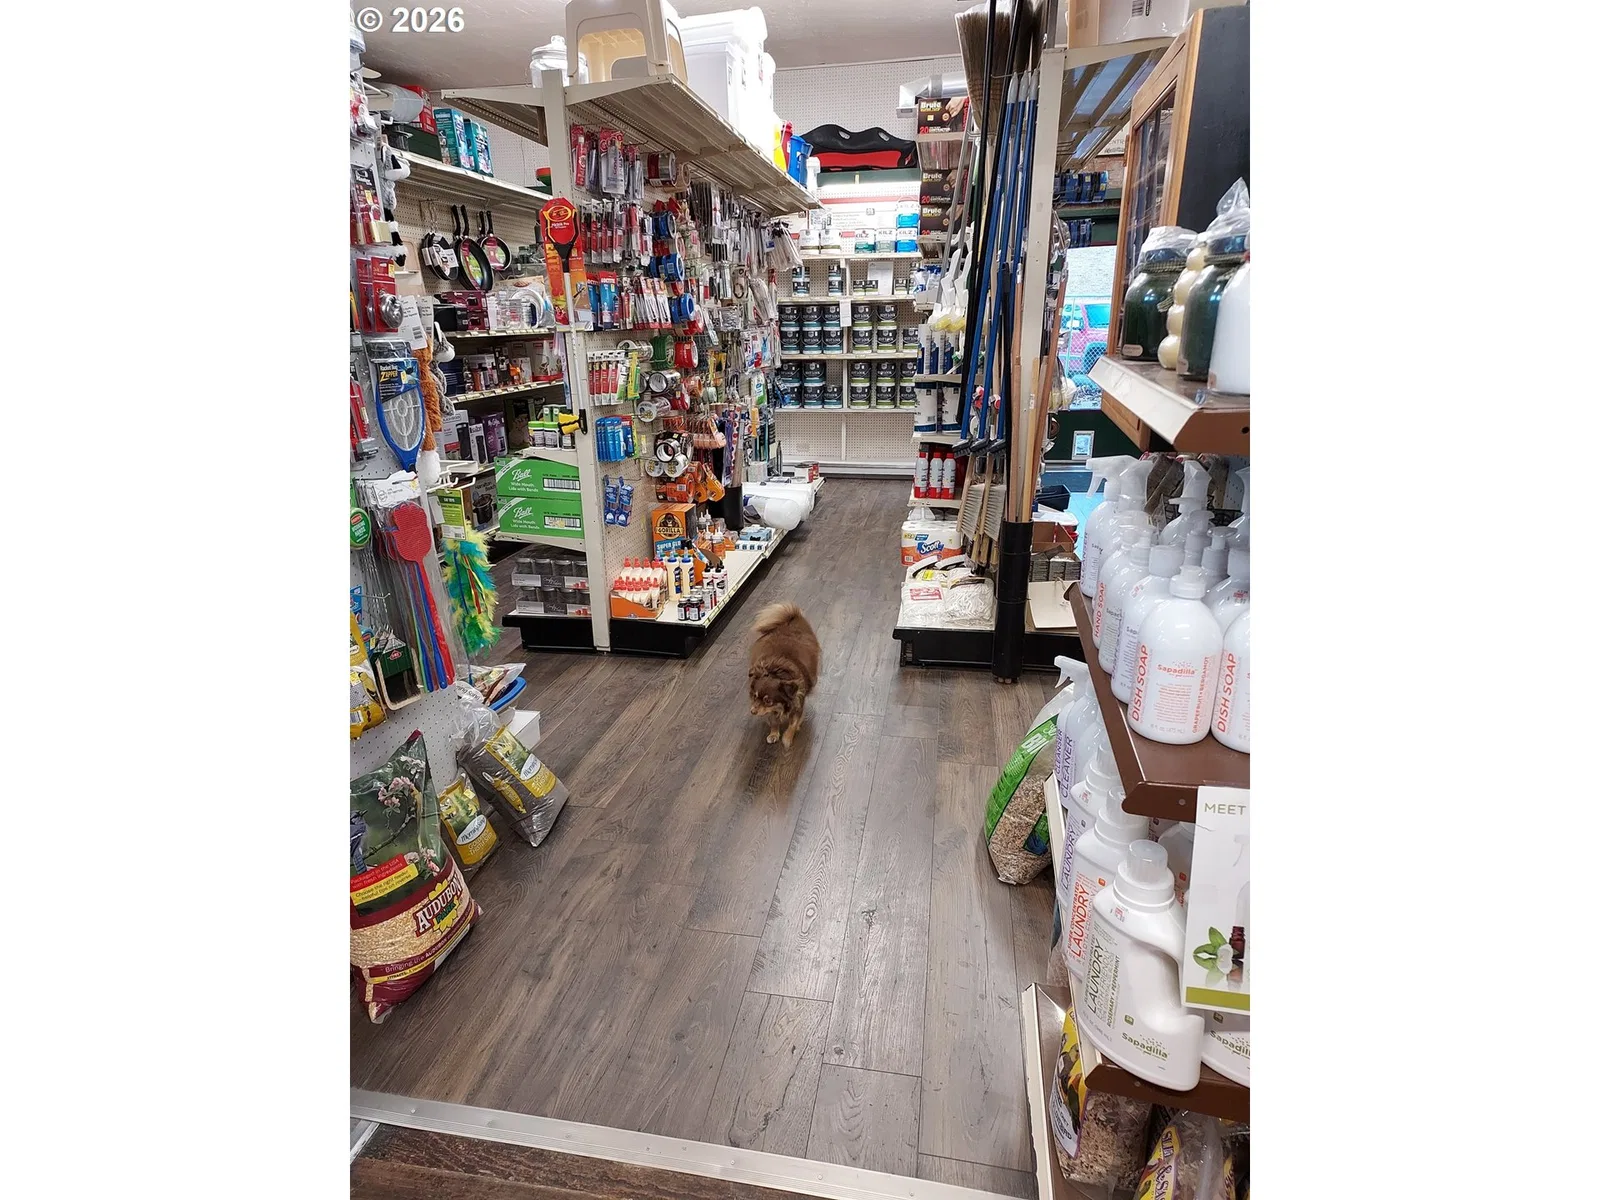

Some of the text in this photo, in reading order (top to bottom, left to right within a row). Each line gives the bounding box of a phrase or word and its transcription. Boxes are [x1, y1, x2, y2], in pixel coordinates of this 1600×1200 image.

[920, 126, 929, 134] 20
[921, 195, 930, 204] 20
[511, 468, 532, 482] Ball
[513, 506, 533, 519] Ball
[920, 540, 940, 553] Scott
[1098, 582, 1106, 609] SOAP
[1157, 664, 1195, 675] Sapadilla
[1131, 645, 1148, 722] DISH SOAP
[1217, 653, 1237, 733] DISH SOAP
[1062, 736, 1073, 798] CLEANER
[1204, 803, 1247, 816] MEET
[1061, 828, 1077, 889] LAUNDRY
[416, 874, 462, 933] AUDUBON
[1070, 881, 1081, 930] CONCENTRATED
[1071, 884, 1089, 958] LAUNDRY
[385, 960, 413, 973] Bringing
[1088, 938, 1104, 1014] LAUNDRY
[1107, 997, 1115, 1028] ROSEMARY
[1111, 955, 1120, 991] PEPPERMINT
[1122, 1032, 1168, 1058] Sapadilla
